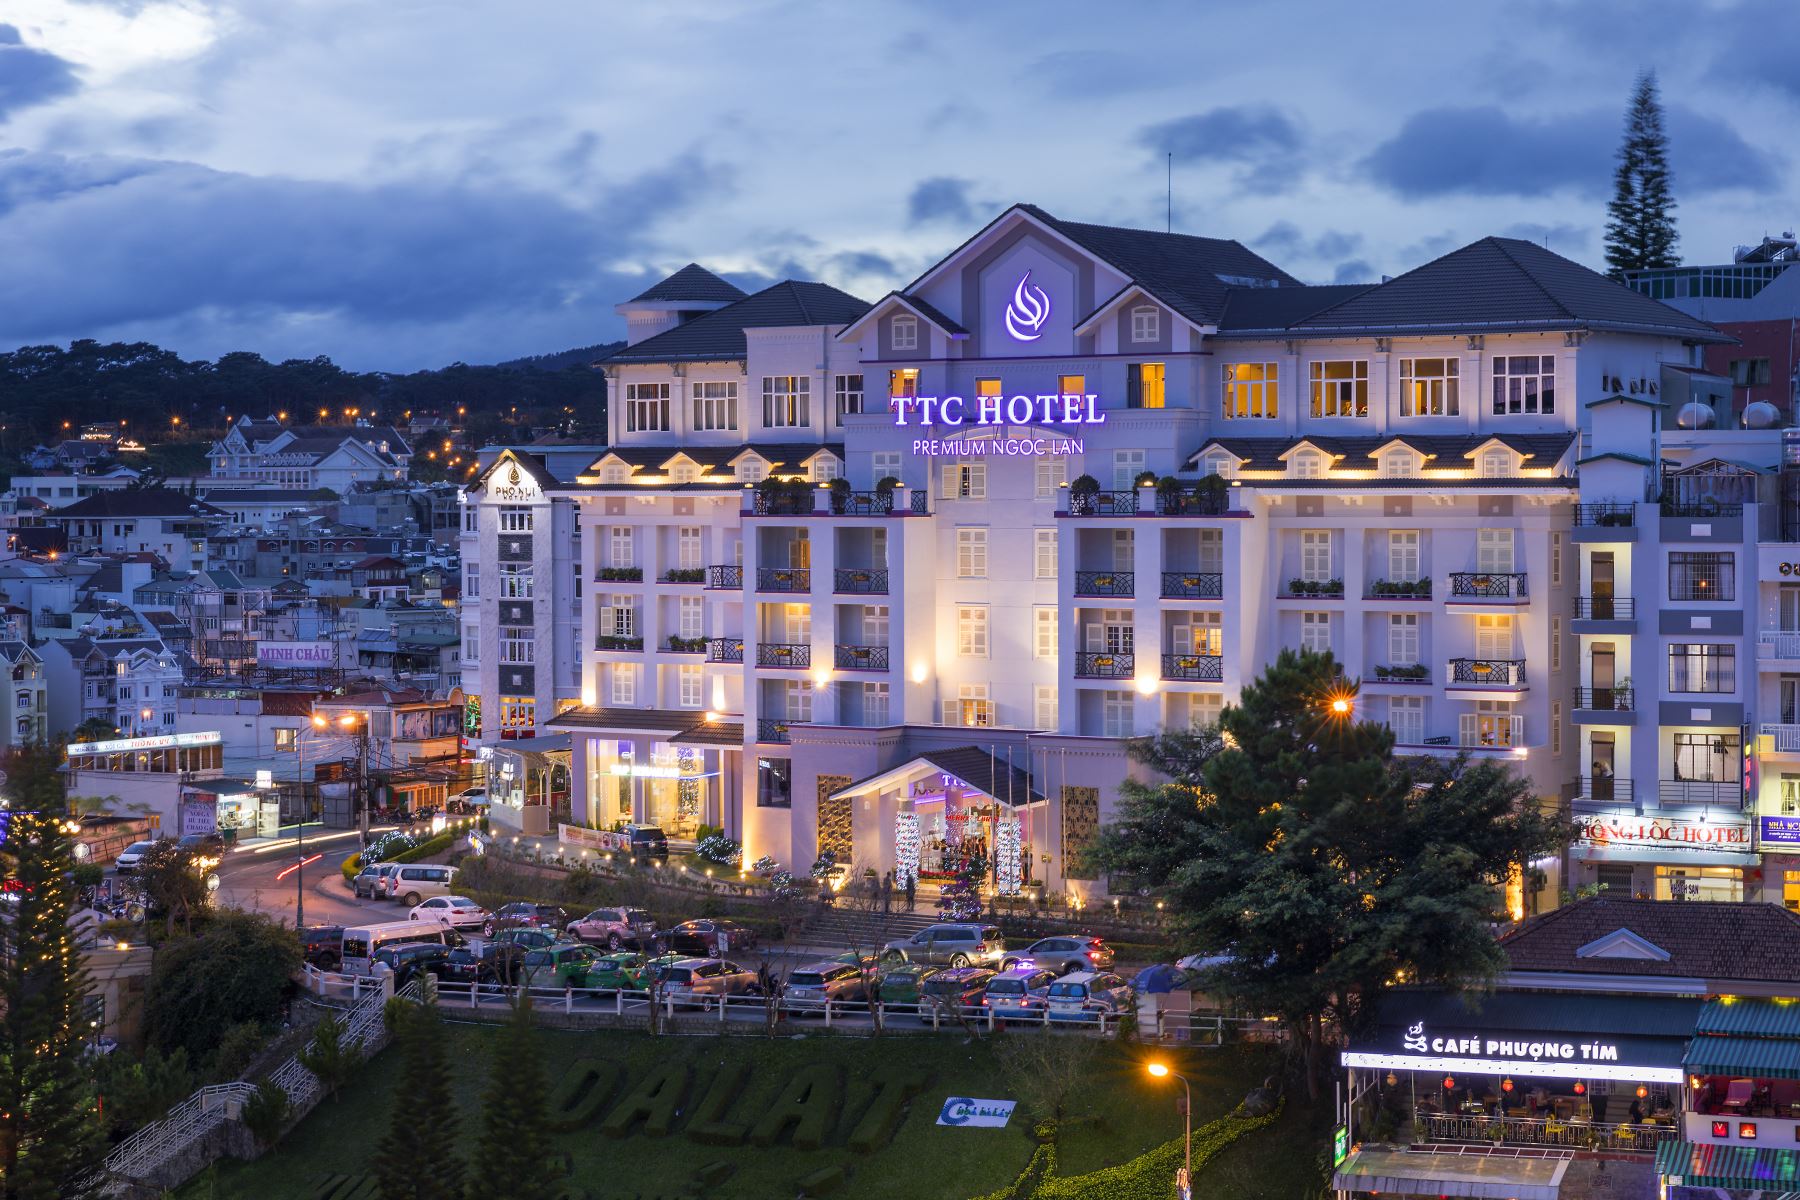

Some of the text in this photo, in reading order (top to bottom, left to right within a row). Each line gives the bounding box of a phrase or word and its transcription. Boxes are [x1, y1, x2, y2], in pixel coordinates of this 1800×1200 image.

[890, 394, 1105, 426] TTC HOTEL
[913, 438, 1084, 456] PREMIUM NGOC LAN
[260, 644, 330, 661] MINH CHÂU
[1684, 826, 1750, 843] HOTEL
[1431, 1035, 1618, 1062] CAFÉ PHƯỢNG TÍM
[544, 1057, 930, 1153] DALAT
